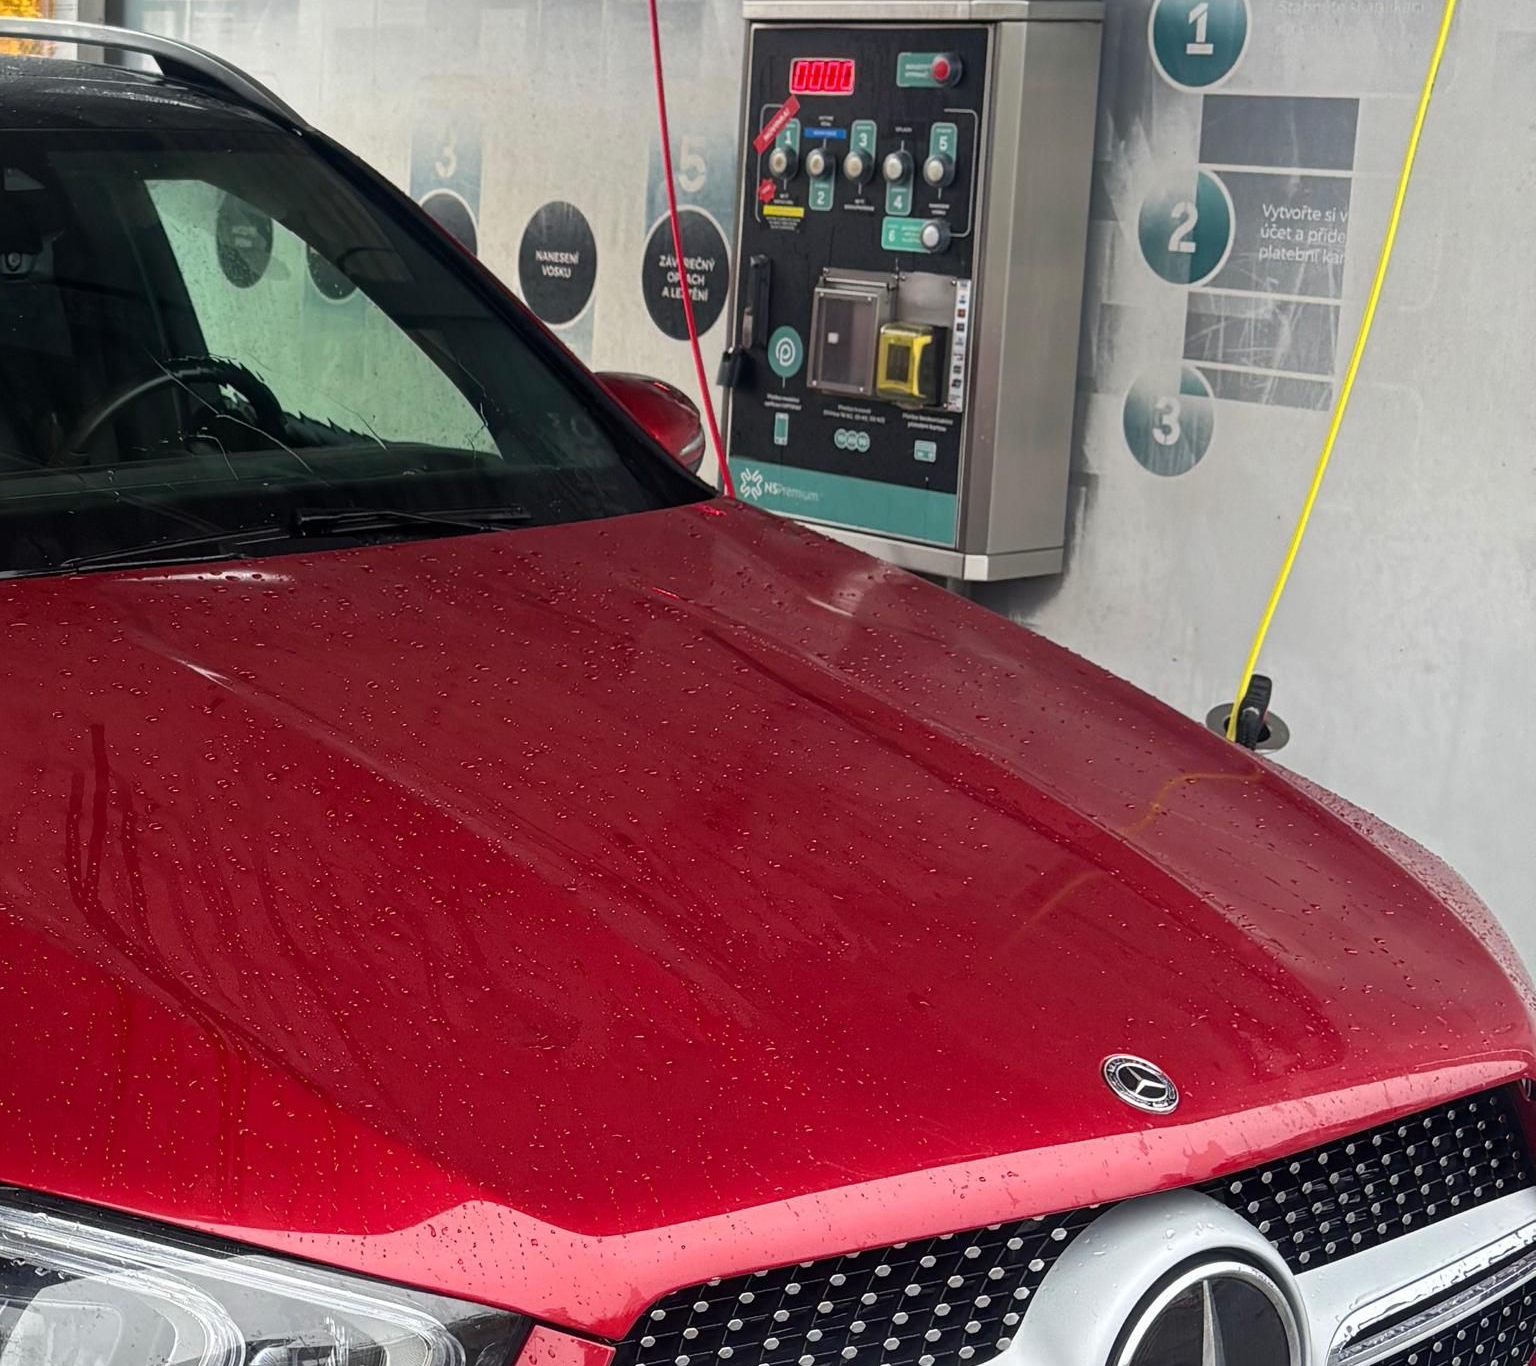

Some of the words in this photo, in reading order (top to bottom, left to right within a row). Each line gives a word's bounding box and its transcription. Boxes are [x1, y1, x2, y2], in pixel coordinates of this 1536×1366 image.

[1186, 2, 1214, 56] 1
[859, 133, 868, 148] 3
[939, 135, 948, 151] 5
[678, 137, 707, 192] 5
[817, 190, 826, 204] 2
[893, 195, 904, 210] 4
[1262, 203, 1322, 222] Vytvořte
[1325, 207, 1337, 222] si
[1168, 200, 1199, 253] 2
[1260, 223, 1292, 240] účet
[1295, 229, 1304, 241] a
[535, 250, 579, 264] NANESENÍ
[1259, 243, 1321, 263] platební
[659, 253, 715, 271] ZÁVREČNÝ
[541, 265, 571, 278] VOSKU
[667, 271, 705, 285] OPACH
[661, 286, 670, 298] A
[1152, 395, 1181, 446] 3
